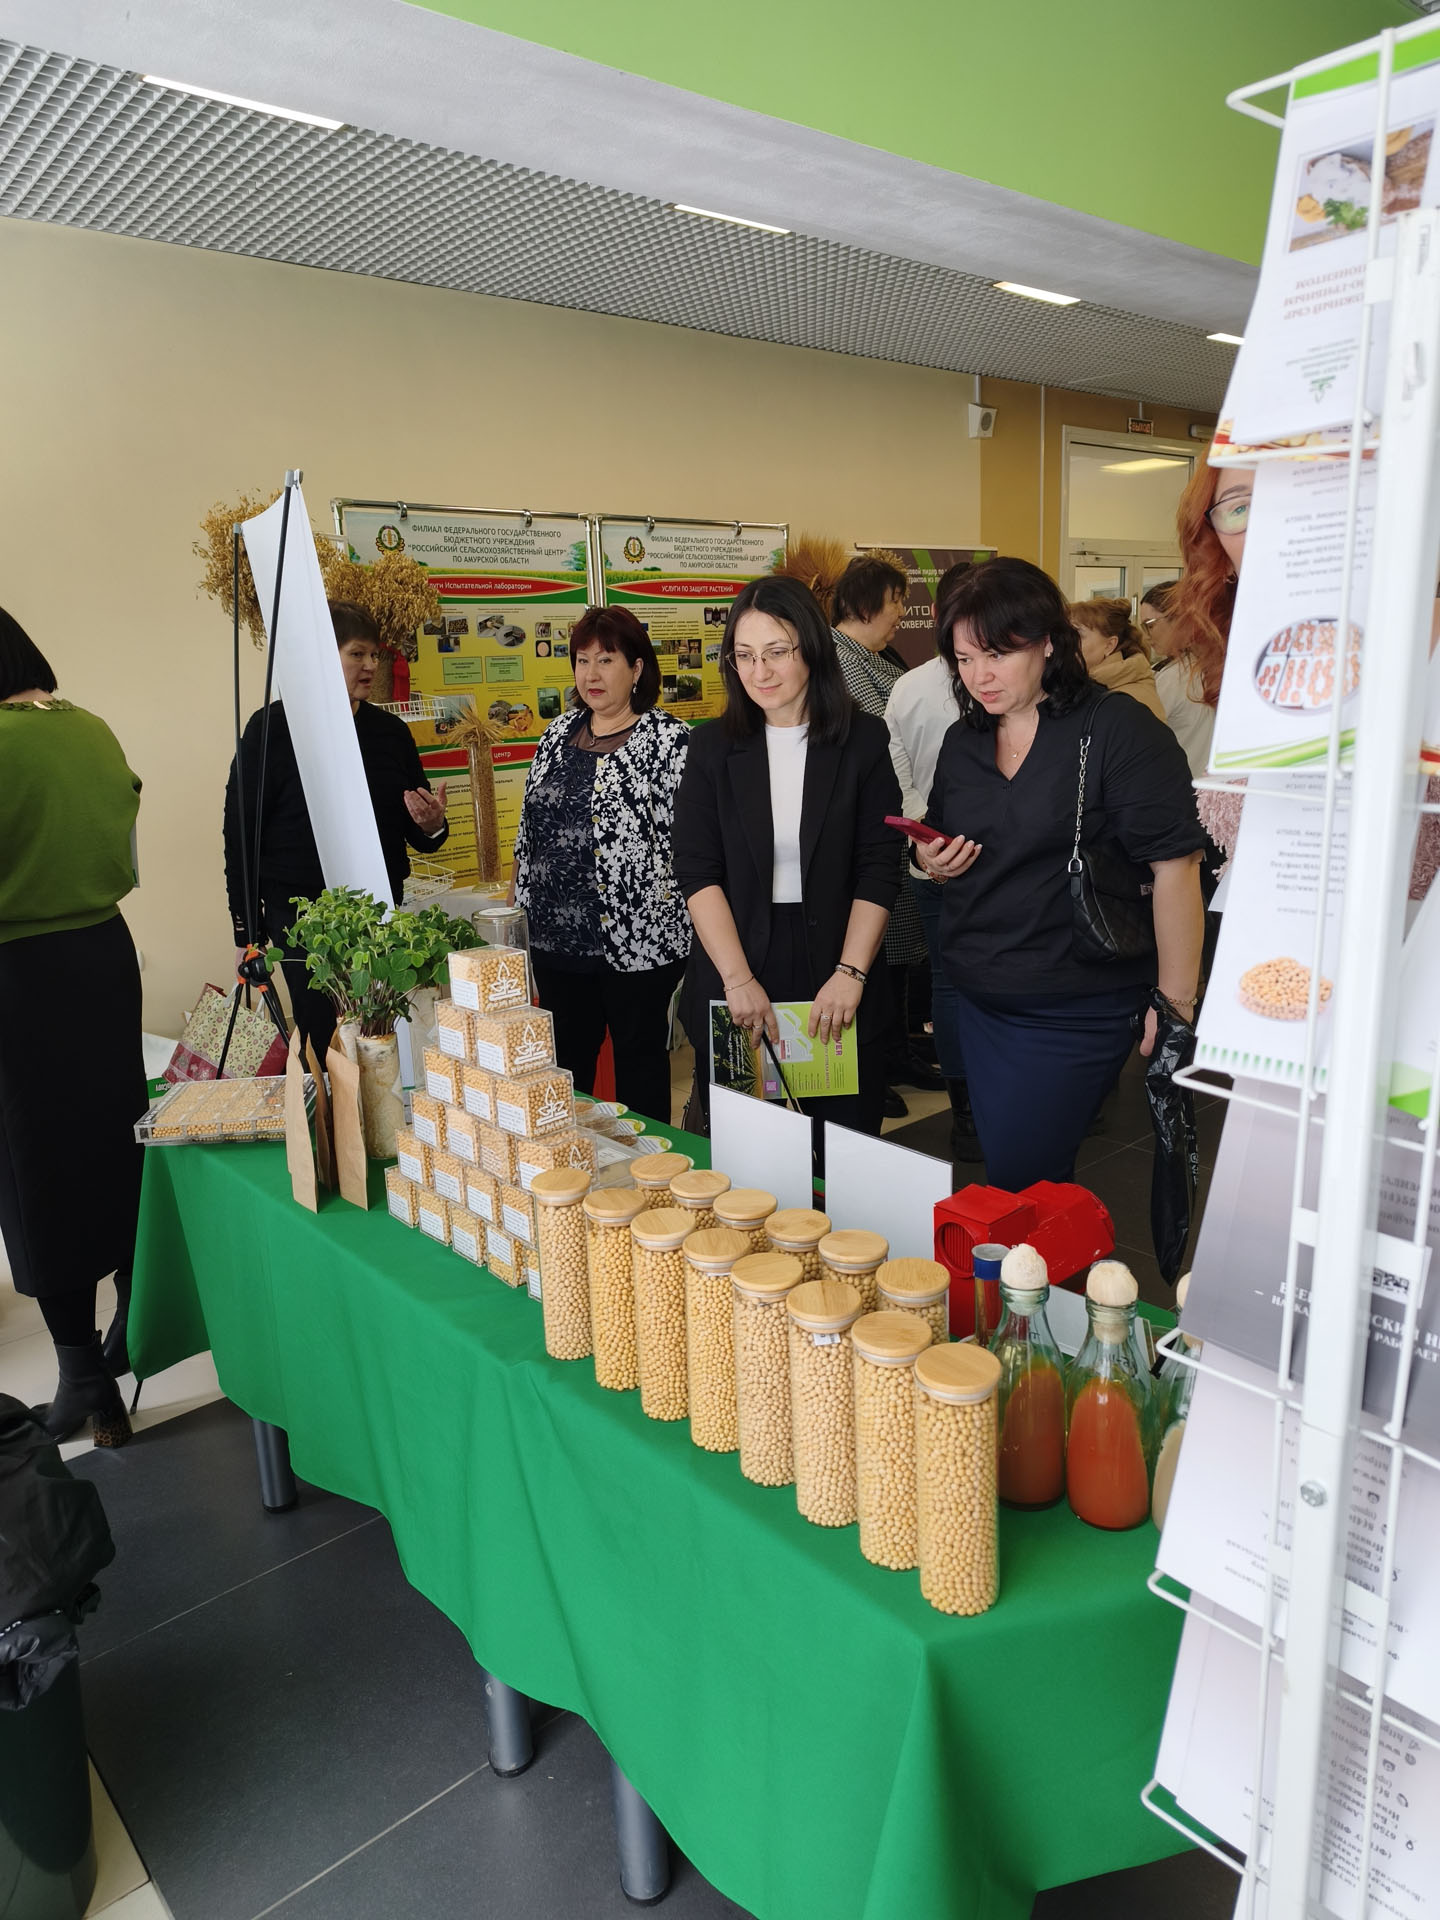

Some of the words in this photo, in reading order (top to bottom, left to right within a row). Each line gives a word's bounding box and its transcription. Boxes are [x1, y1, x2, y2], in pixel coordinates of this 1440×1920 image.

[412, 525, 442, 533] ФИЛИАЛ
[443, 526, 496, 536] ФЕДЕРАЛЬНОГО
[498, 528, 561, 538] ГОСУДАРСТВЕННОГО
[443, 536, 491, 546] БЮДЖЕТНОГО
[493, 538, 535, 546] УЧРЕЖДЕНИЯ
[674, 537, 713, 546] ФЕДЕРАЛЬНОГО
[714, 538, 764, 547] ГОСУДАРСТВЕННОГО
[459, 546, 543, 556] СЕЛЬСКОХОЗЯЙСТВЕННЫЙ
[674, 545, 709, 553] БЮДЖЕТНОГО
[710, 546, 743, 554] УЧРЕЖДЕНИЯ
[463, 555, 499, 564] АМУРСКОЙ
[499, 557, 530, 565] ОБЛАСТИ
[685, 553, 749, 562] СЕЛЬСКОХОЗЯЙСТВЕННЫЙ
[688, 561, 714, 569] АМУРСКОЙ
[445, 582, 492, 590] Испытательной
[494, 582, 532, 591] лаборатории
[661, 585, 681, 593] УСЛУГИ
[689, 585, 708, 593] ЗАЩИТЕ
[709, 584, 734, 593] РАСТЕНИЙ
[493, 751, 511, 759] центр
